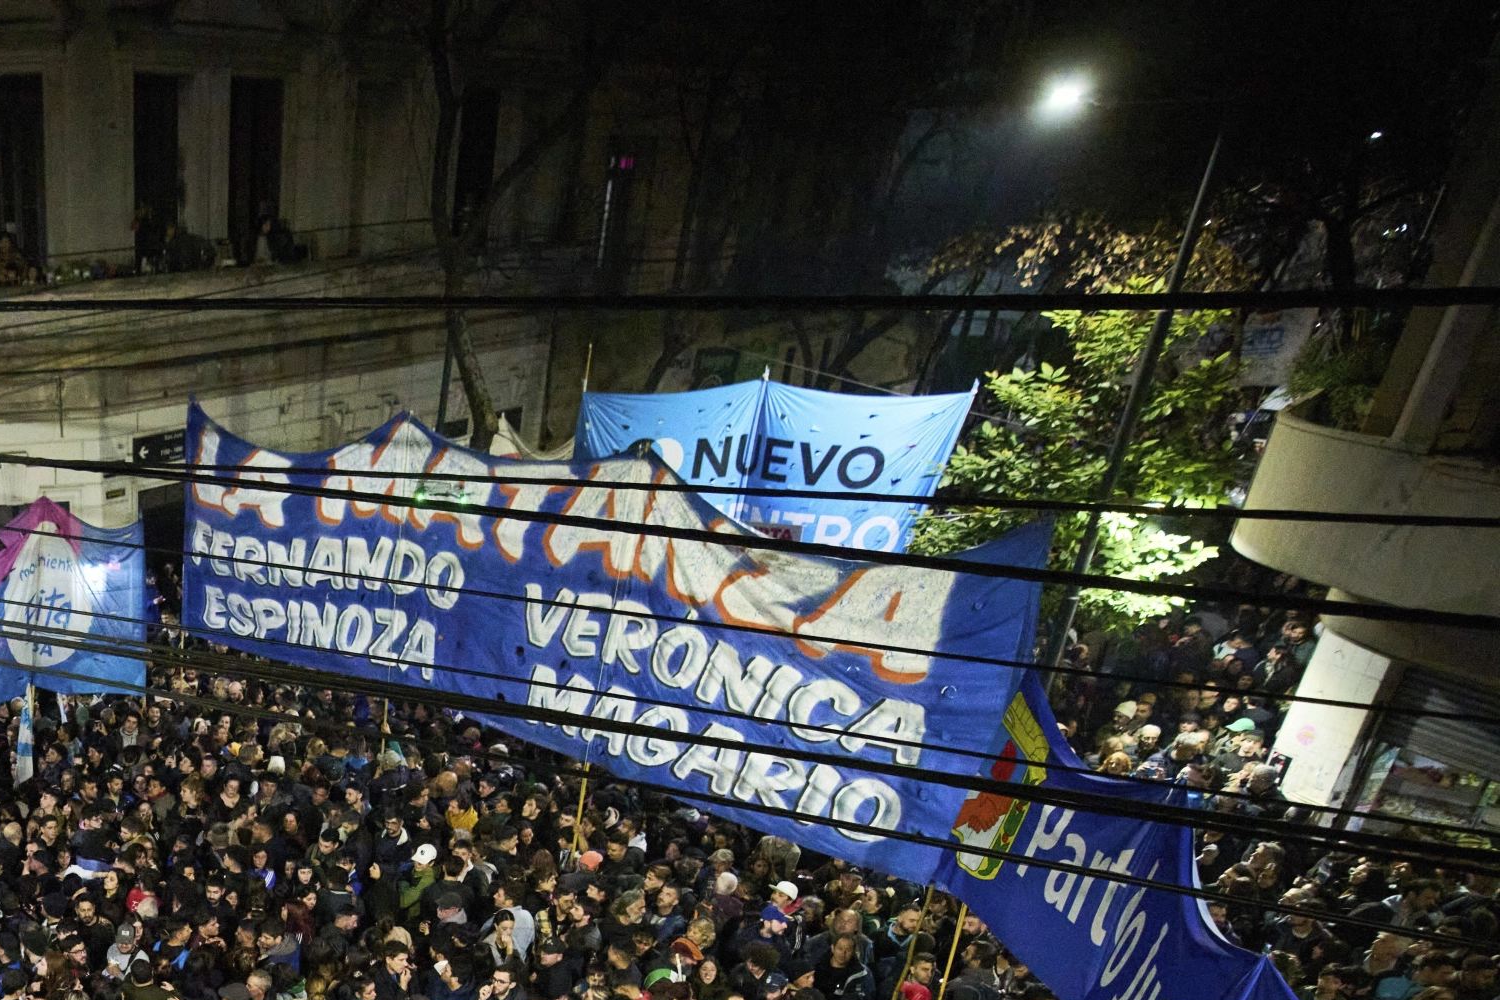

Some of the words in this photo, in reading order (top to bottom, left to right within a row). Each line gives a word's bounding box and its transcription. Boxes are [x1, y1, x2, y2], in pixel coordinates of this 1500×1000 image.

[691, 433, 886, 490] NUEVO
[192, 424, 292, 528] LA
[317, 416, 959, 684] MATANZA
[192, 519, 464, 610] FERNANDO
[203, 582, 436, 682] ESPINOZA
[525, 582, 929, 769] VERÓNICA
[528, 662, 905, 843] MAGARIO
